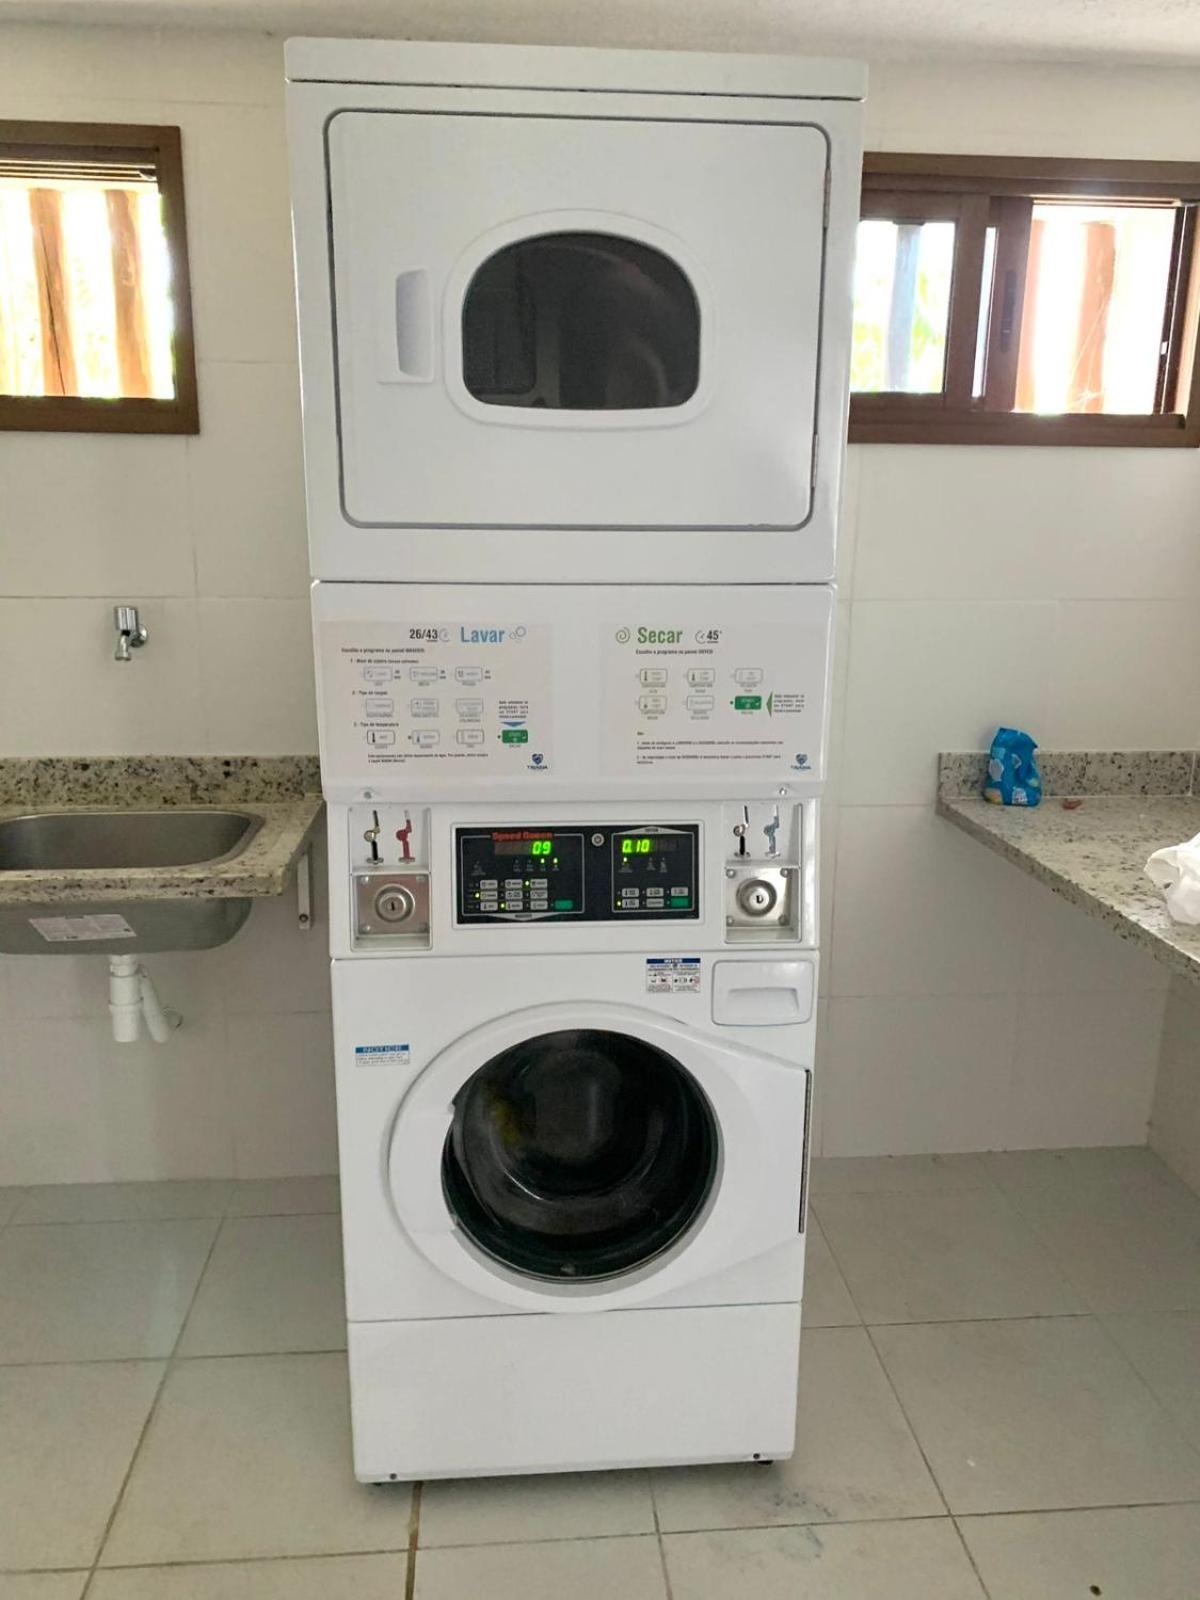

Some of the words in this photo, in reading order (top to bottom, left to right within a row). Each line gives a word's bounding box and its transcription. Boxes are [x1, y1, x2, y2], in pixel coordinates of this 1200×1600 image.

[409, 629, 438, 640] 26/43
[460, 627, 505, 644] Lavar
[637, 627, 683, 644] Secar
[532, 841, 551, 855] 09
